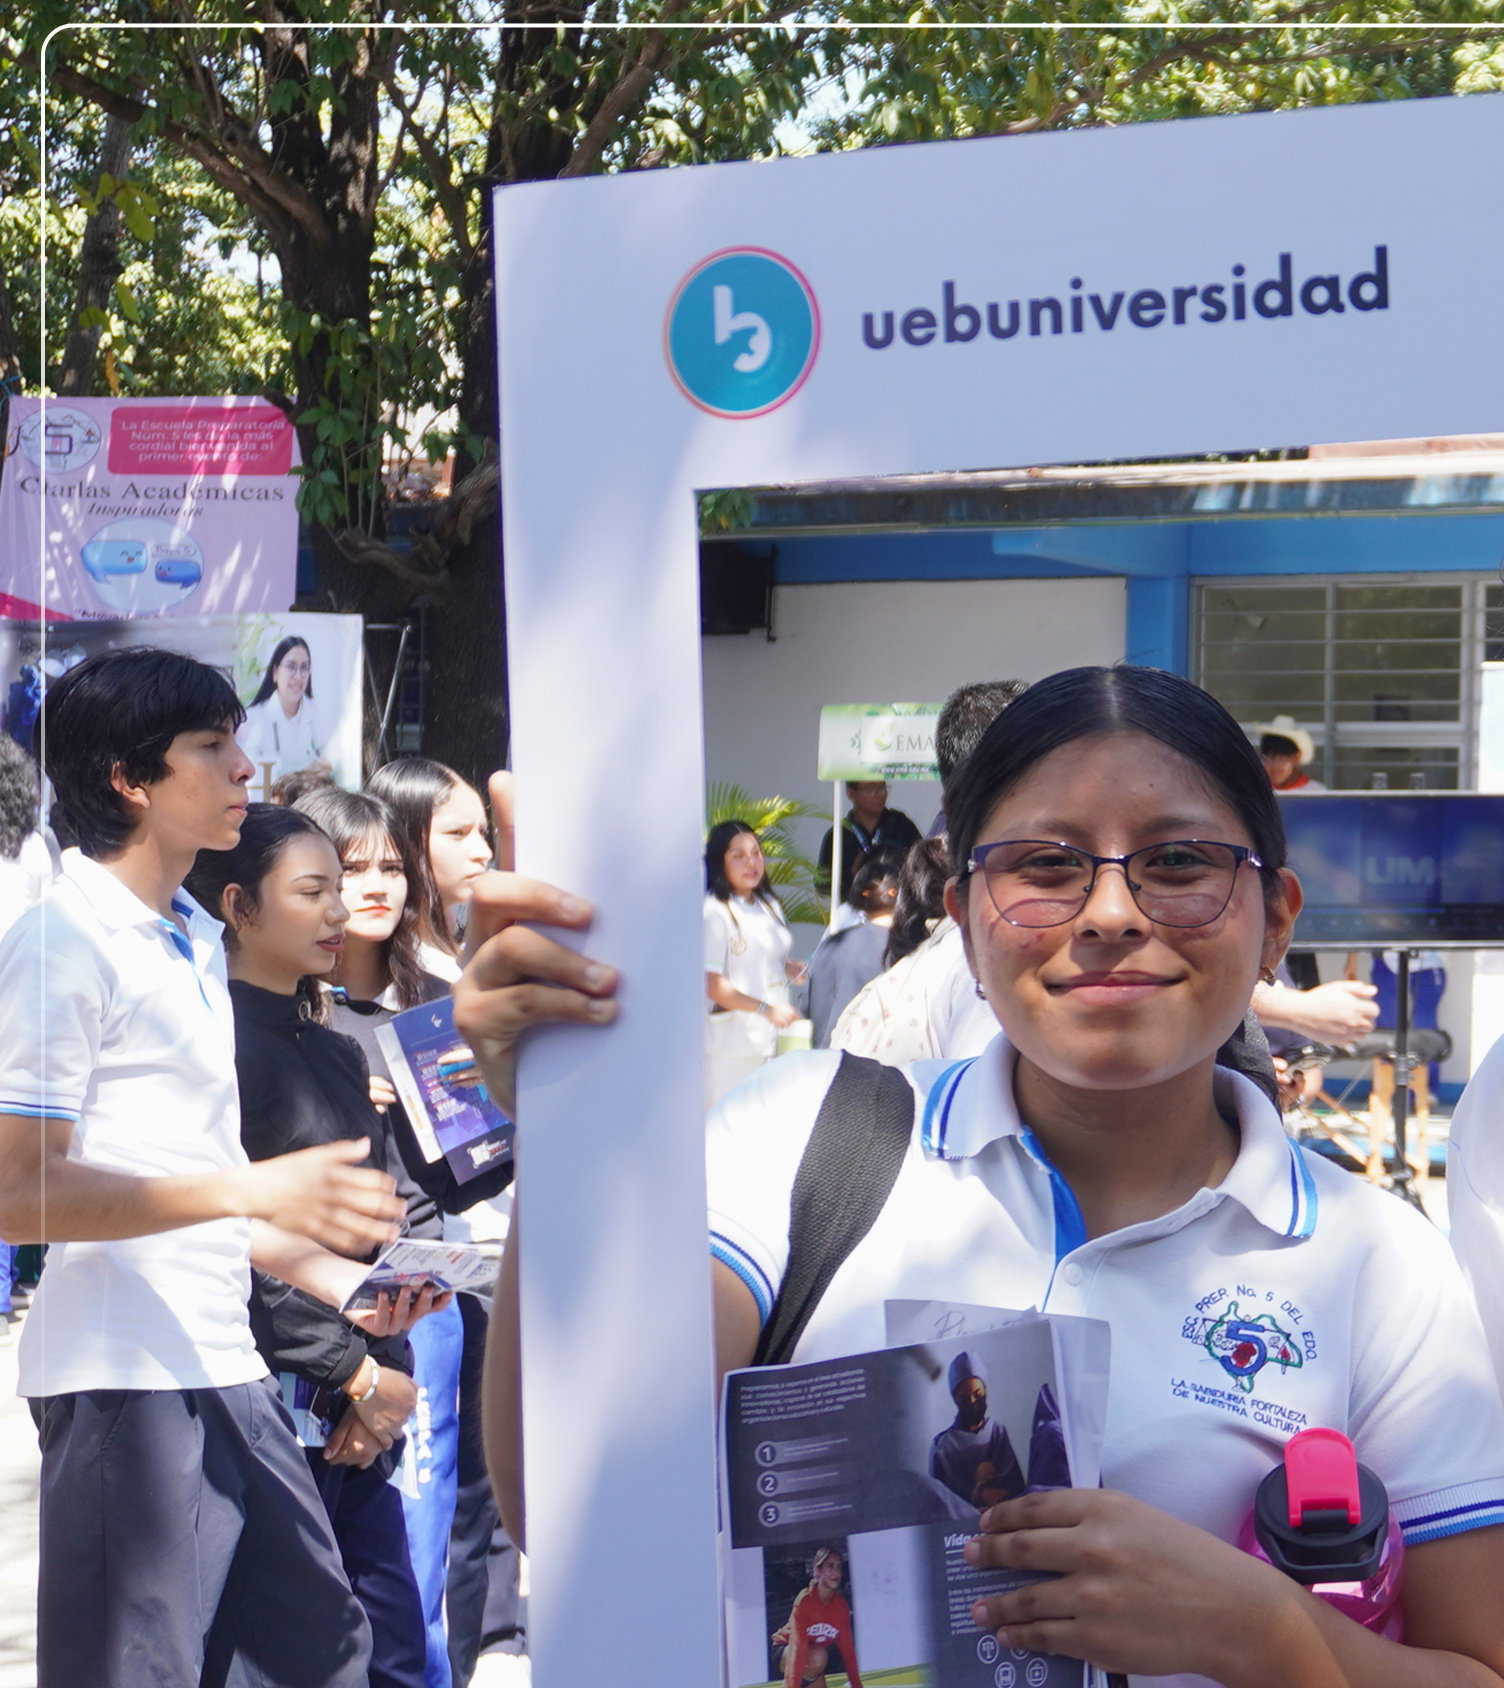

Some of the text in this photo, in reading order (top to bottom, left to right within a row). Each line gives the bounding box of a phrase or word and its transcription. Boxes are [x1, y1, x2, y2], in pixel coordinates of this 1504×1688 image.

[860, 243, 1391, 351] uebuniversidad
[121, 418, 286, 432] La Escuela Preparatoria
[183, 431, 201, 440] les
[227, 431, 239, 440] la
[243, 431, 274, 440] más
[129, 440, 274, 451] cordial bienvenida al
[138, 450, 185, 463] primer
[187, 451, 237, 461] evento
[122, 480, 285, 501] Académicas
[87, 502, 205, 519] Inspiradoras
[1365, 856, 1437, 886] UM
[1265, 1291, 1275, 1302] 5
[1280, 1300, 1305, 1326] DEL
[1220, 1319, 1268, 1377] 5
[755, 1388, 802, 1400] conocimientos
[1170, 1377, 1308, 1426] LA SABIDURIA FORTALEZA
[1172, 1387, 1302, 1435] DE NUESTRA CULTURA
[762, 1446, 772, 1462] 1
[764, 1476, 775, 1492] 2
[766, 1507, 777, 1522] 3
[944, 1533, 971, 1548] Vida
